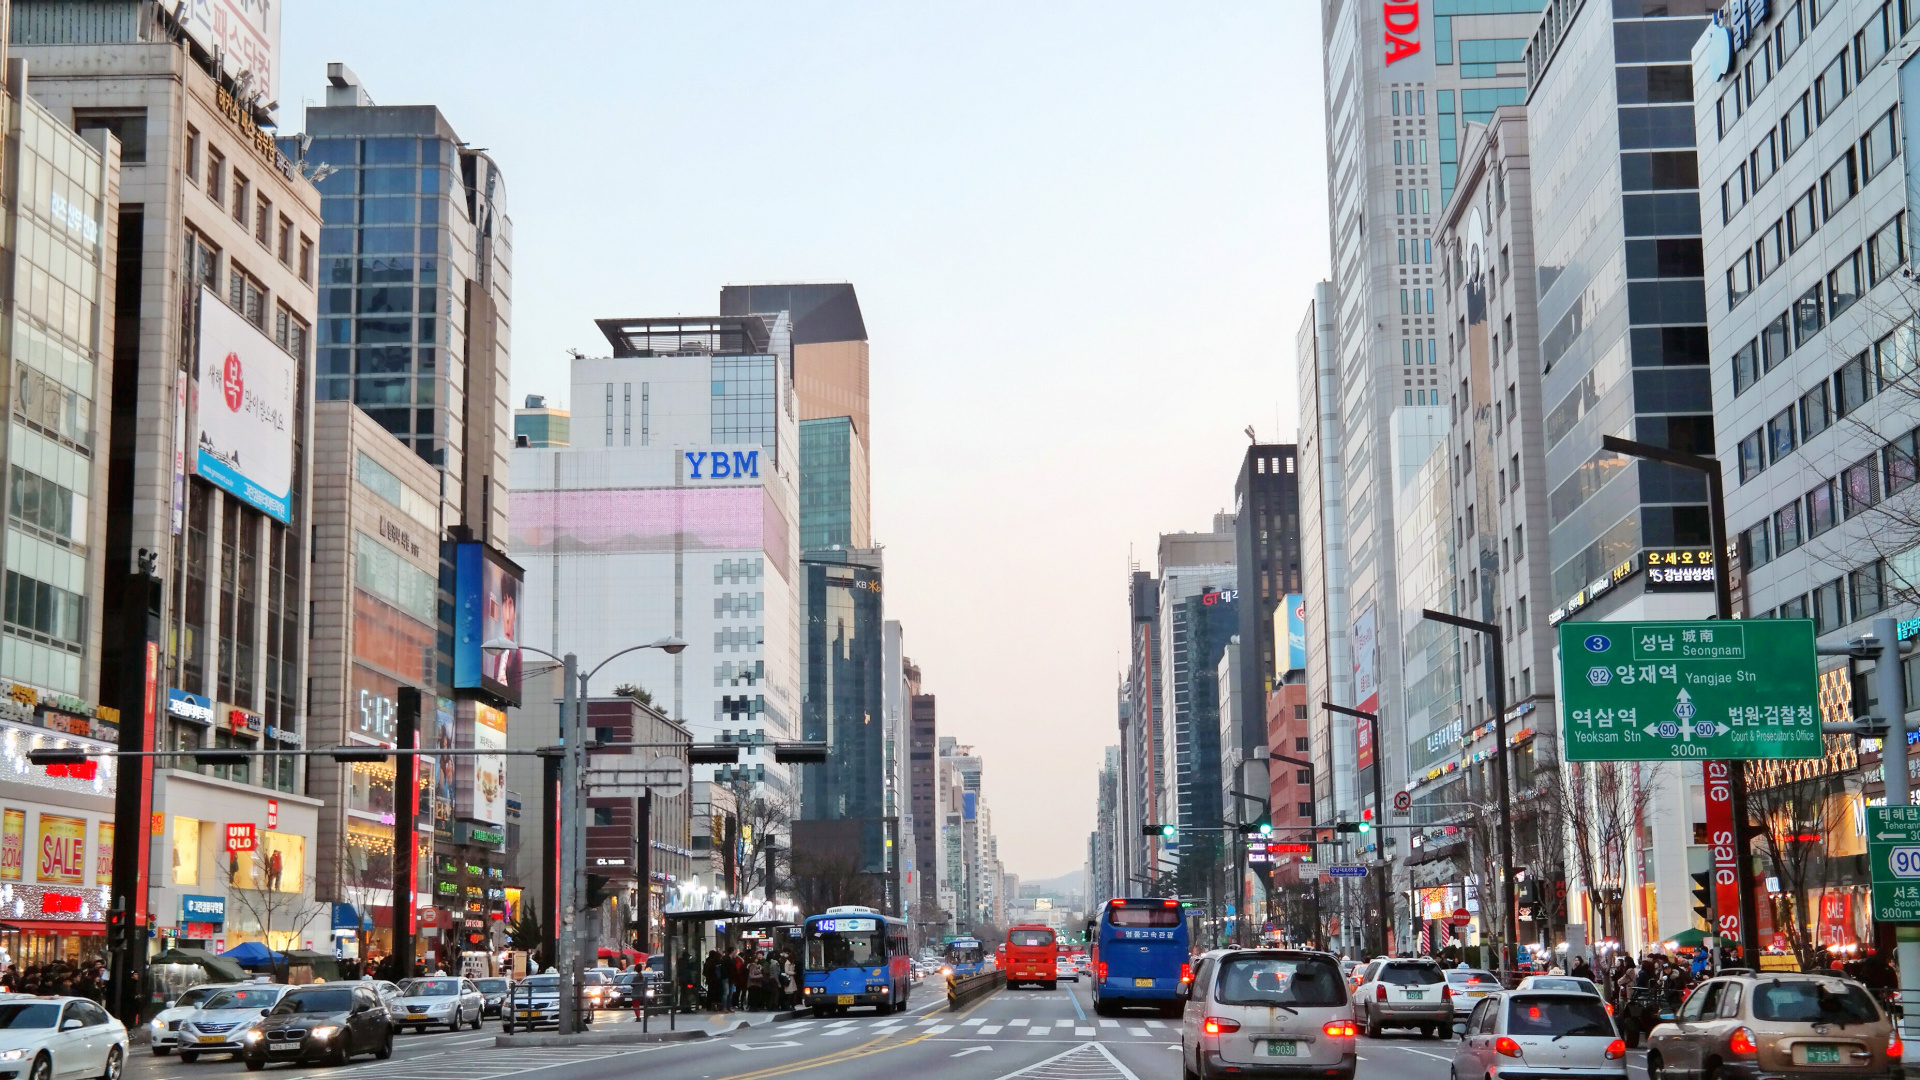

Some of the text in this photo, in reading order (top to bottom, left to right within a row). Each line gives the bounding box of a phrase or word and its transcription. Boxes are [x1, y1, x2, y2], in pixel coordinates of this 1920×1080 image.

[1383, 0, 1421, 67] DA
[191, 0, 270, 100] 스패스닷컴
[256, 127, 275, 162] 공무원
[685, 450, 759, 479] YBM
[855, 580, 867, 589] KB
[1202, 591, 1220, 606] GT
[1592, 637, 1603, 650] 3
[1640, 633, 1675, 652] 성남
[1682, 644, 1742, 657] Seongnam
[1592, 670, 1607, 683] 92
[1616, 664, 1756, 687] 양재역 Yangjae Stn
[1571, 707, 1637, 727] 역삼역
[1679, 705, 1691, 716] 41
[1729, 706, 1813, 726] 법원·검찰청
[1574, 730, 1642, 743] Yeoksam Stn
[1662, 724, 1675, 736] 90
[1699, 724, 1712, 736] 90
[1731, 731, 1814, 742] Court & Prosecutor's Office
[1671, 744, 1707, 757] 300m
[1708, 762, 1729, 802] ale
[1879, 808, 1920, 821] 테헤란
[229, 827, 250, 837] UNI
[229, 838, 251, 850] QLO
[1, 847, 21, 868] 2014
[42, 834, 82, 876] SALE
[1713, 831, 1736, 885] sale
[1827, 902, 1844, 919] SALE
[1882, 908, 1911, 918] 300m
[818, 919, 835, 931] 145
[1125, 930, 1174, 939] 명품고속관광
[1276, 1045, 1295, 1055] 9030
[1816, 1051, 1840, 1062] 7516
